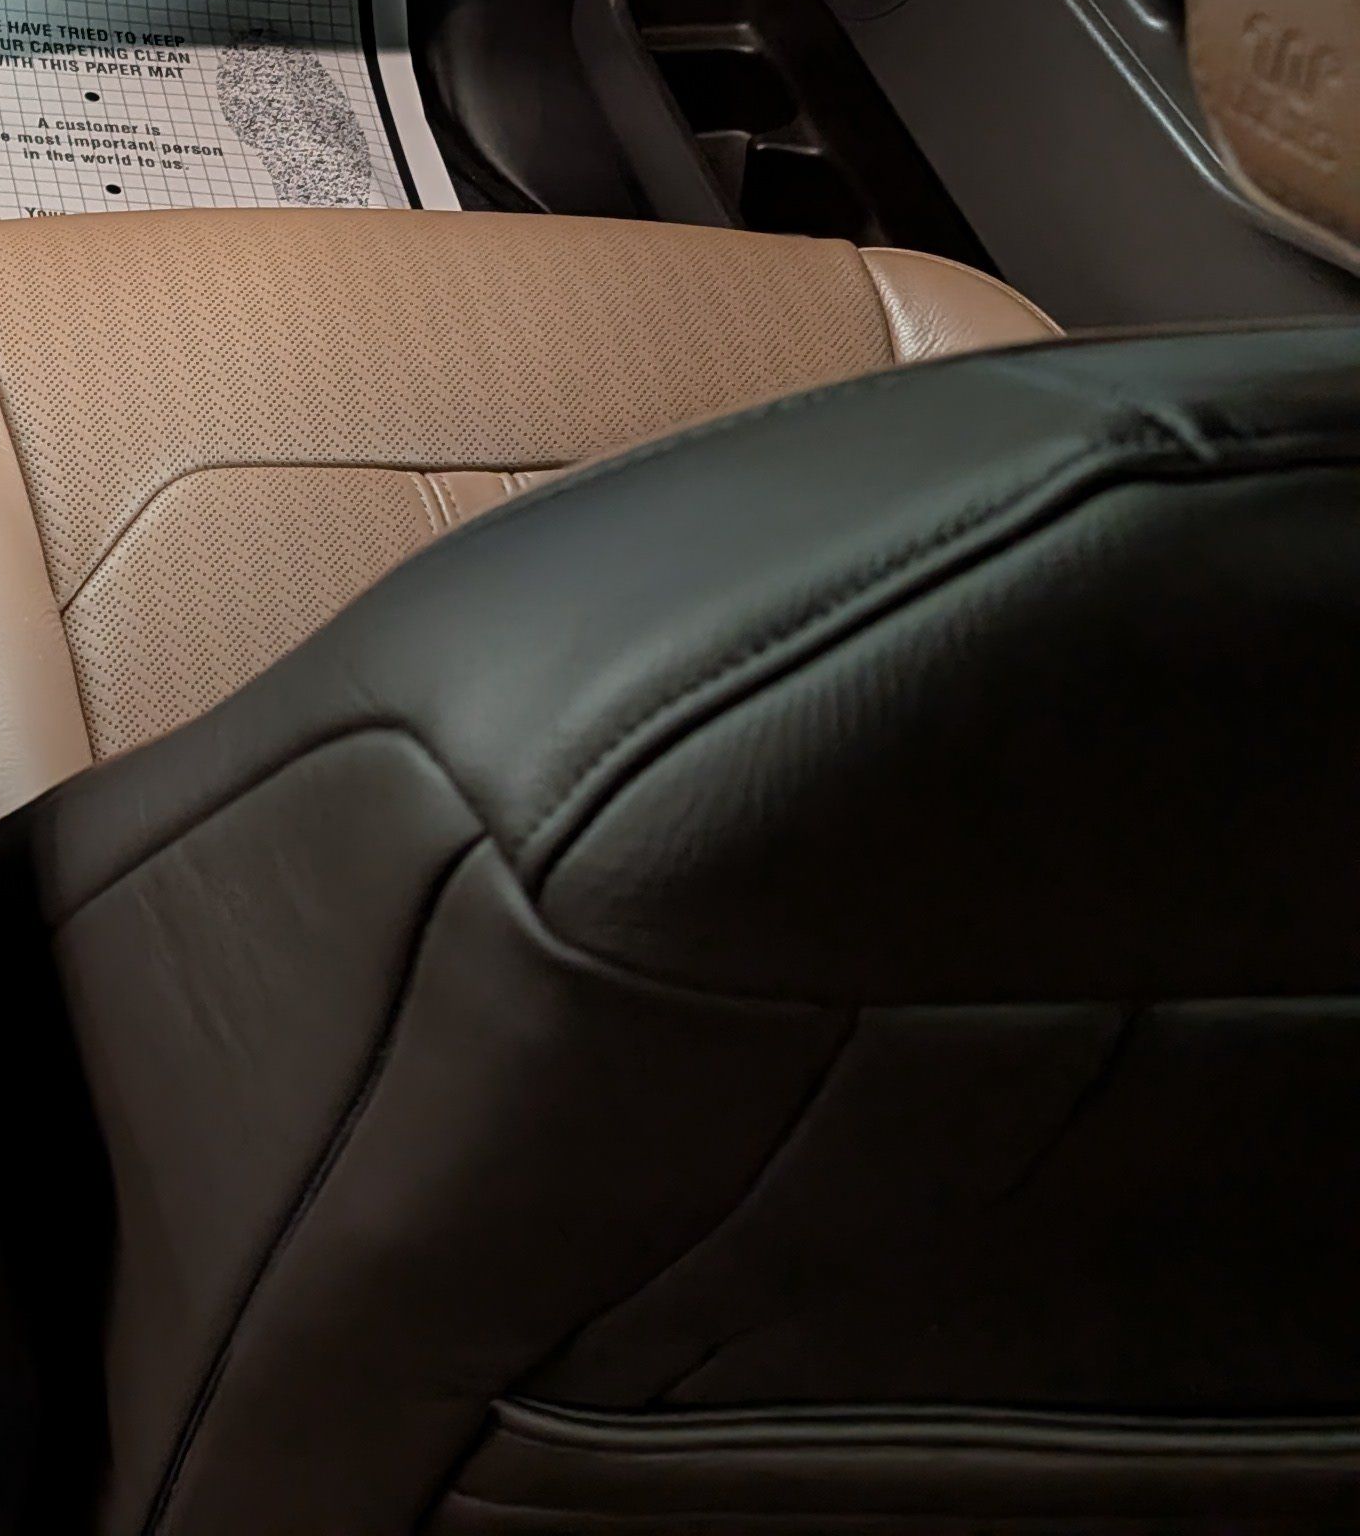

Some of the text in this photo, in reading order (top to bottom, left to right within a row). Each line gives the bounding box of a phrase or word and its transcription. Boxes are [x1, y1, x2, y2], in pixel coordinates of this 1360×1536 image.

[7, 21, 51, 38] HAVE
[57, 25, 108, 42] TRIED
[114, 30, 136, 45] TO
[142, 33, 185, 47] KEEP
[30, 40, 128, 60] CARPETING
[134, 49, 190, 64] CLEAN
[39, 57, 79, 73] THIS
[86, 61, 142, 77] PAPER
[148, 66, 184, 79] MAT
[38, 117, 161, 136] A customer is
[18, 132, 61, 146] most
[67, 135, 155, 152] important
[162, 143, 223, 157] person
[23, 148, 190, 171] in the world to us.
